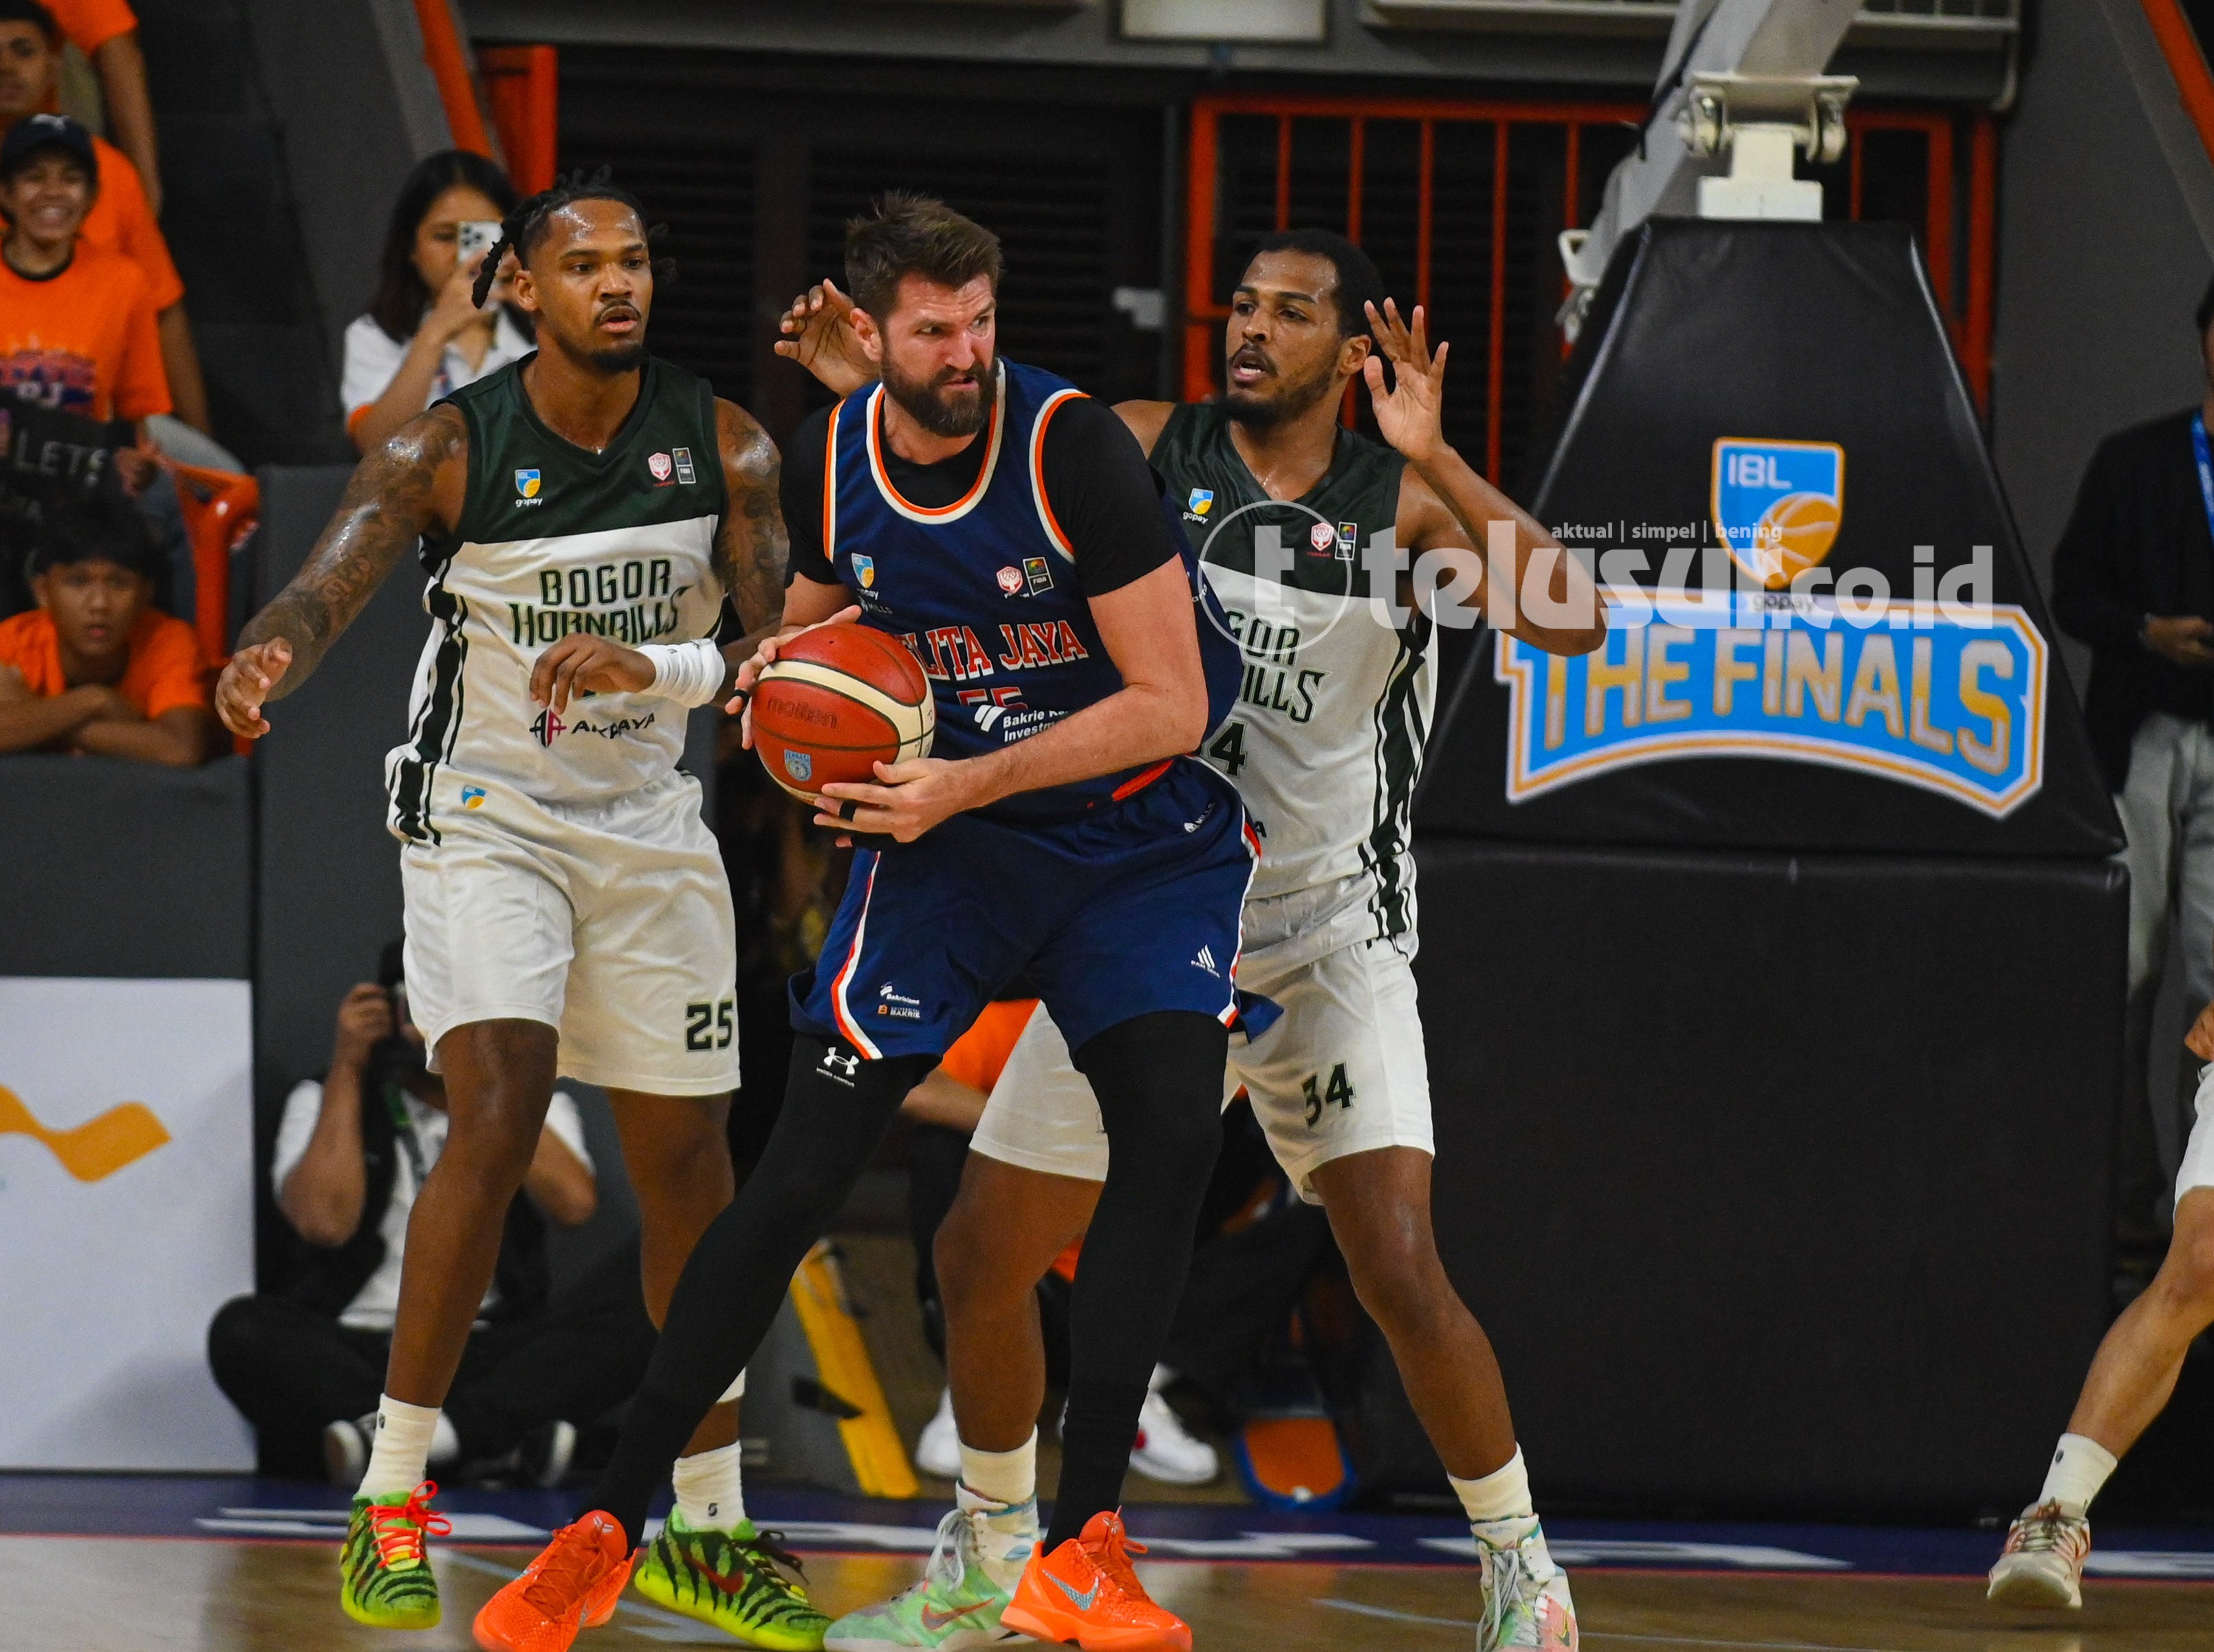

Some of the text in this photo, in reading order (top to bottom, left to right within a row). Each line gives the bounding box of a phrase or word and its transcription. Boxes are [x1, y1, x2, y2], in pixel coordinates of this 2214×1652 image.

[1727, 453, 1792, 490] IBL
[515, 497, 543, 508] gopay
[1182, 511, 1209, 524] gopay
[539, 557, 672, 607] BOGOR
[506, 586, 688, 648] HORNBILLS
[1226, 607, 1303, 666] GOR
[895, 620, 1089, 681] LITA JAYA
[766, 696, 838, 730] molten
[1002, 709, 1045, 728] Bakrie
[1543, 622, 2015, 777] THE FINALS
[1204, 719, 1248, 777] 4
[685, 998, 734, 1052] 25
[890, 1010, 921, 1019] BAKRIE
[1301, 1061, 1356, 1129] 34
